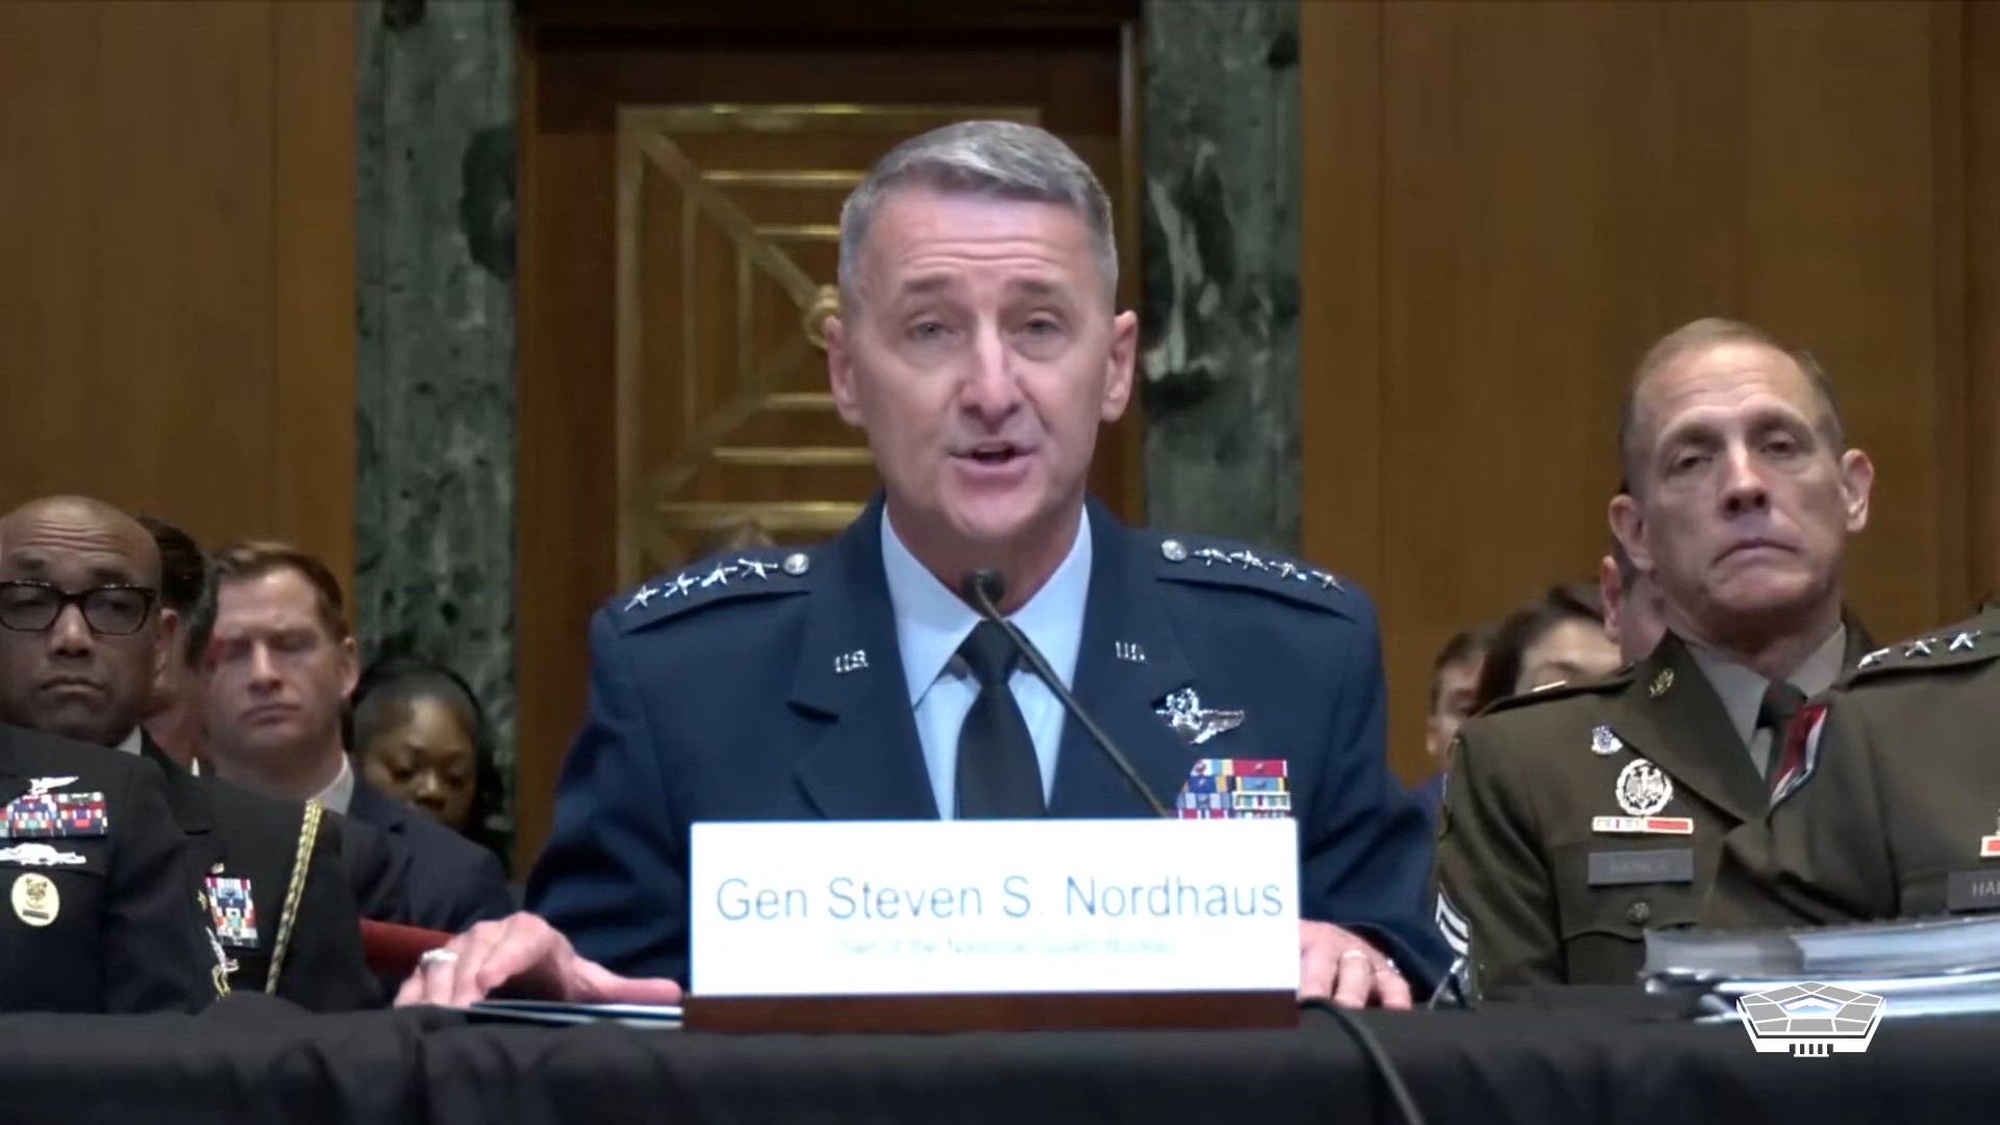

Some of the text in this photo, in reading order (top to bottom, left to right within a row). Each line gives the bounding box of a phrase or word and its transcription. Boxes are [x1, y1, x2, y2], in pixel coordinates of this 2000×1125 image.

[716, 877, 808, 922] Gen
[827, 876, 982, 921] Steven
[1066, 875, 1283, 919] Nordhaus
[1972, 881, 2000, 897] HA
